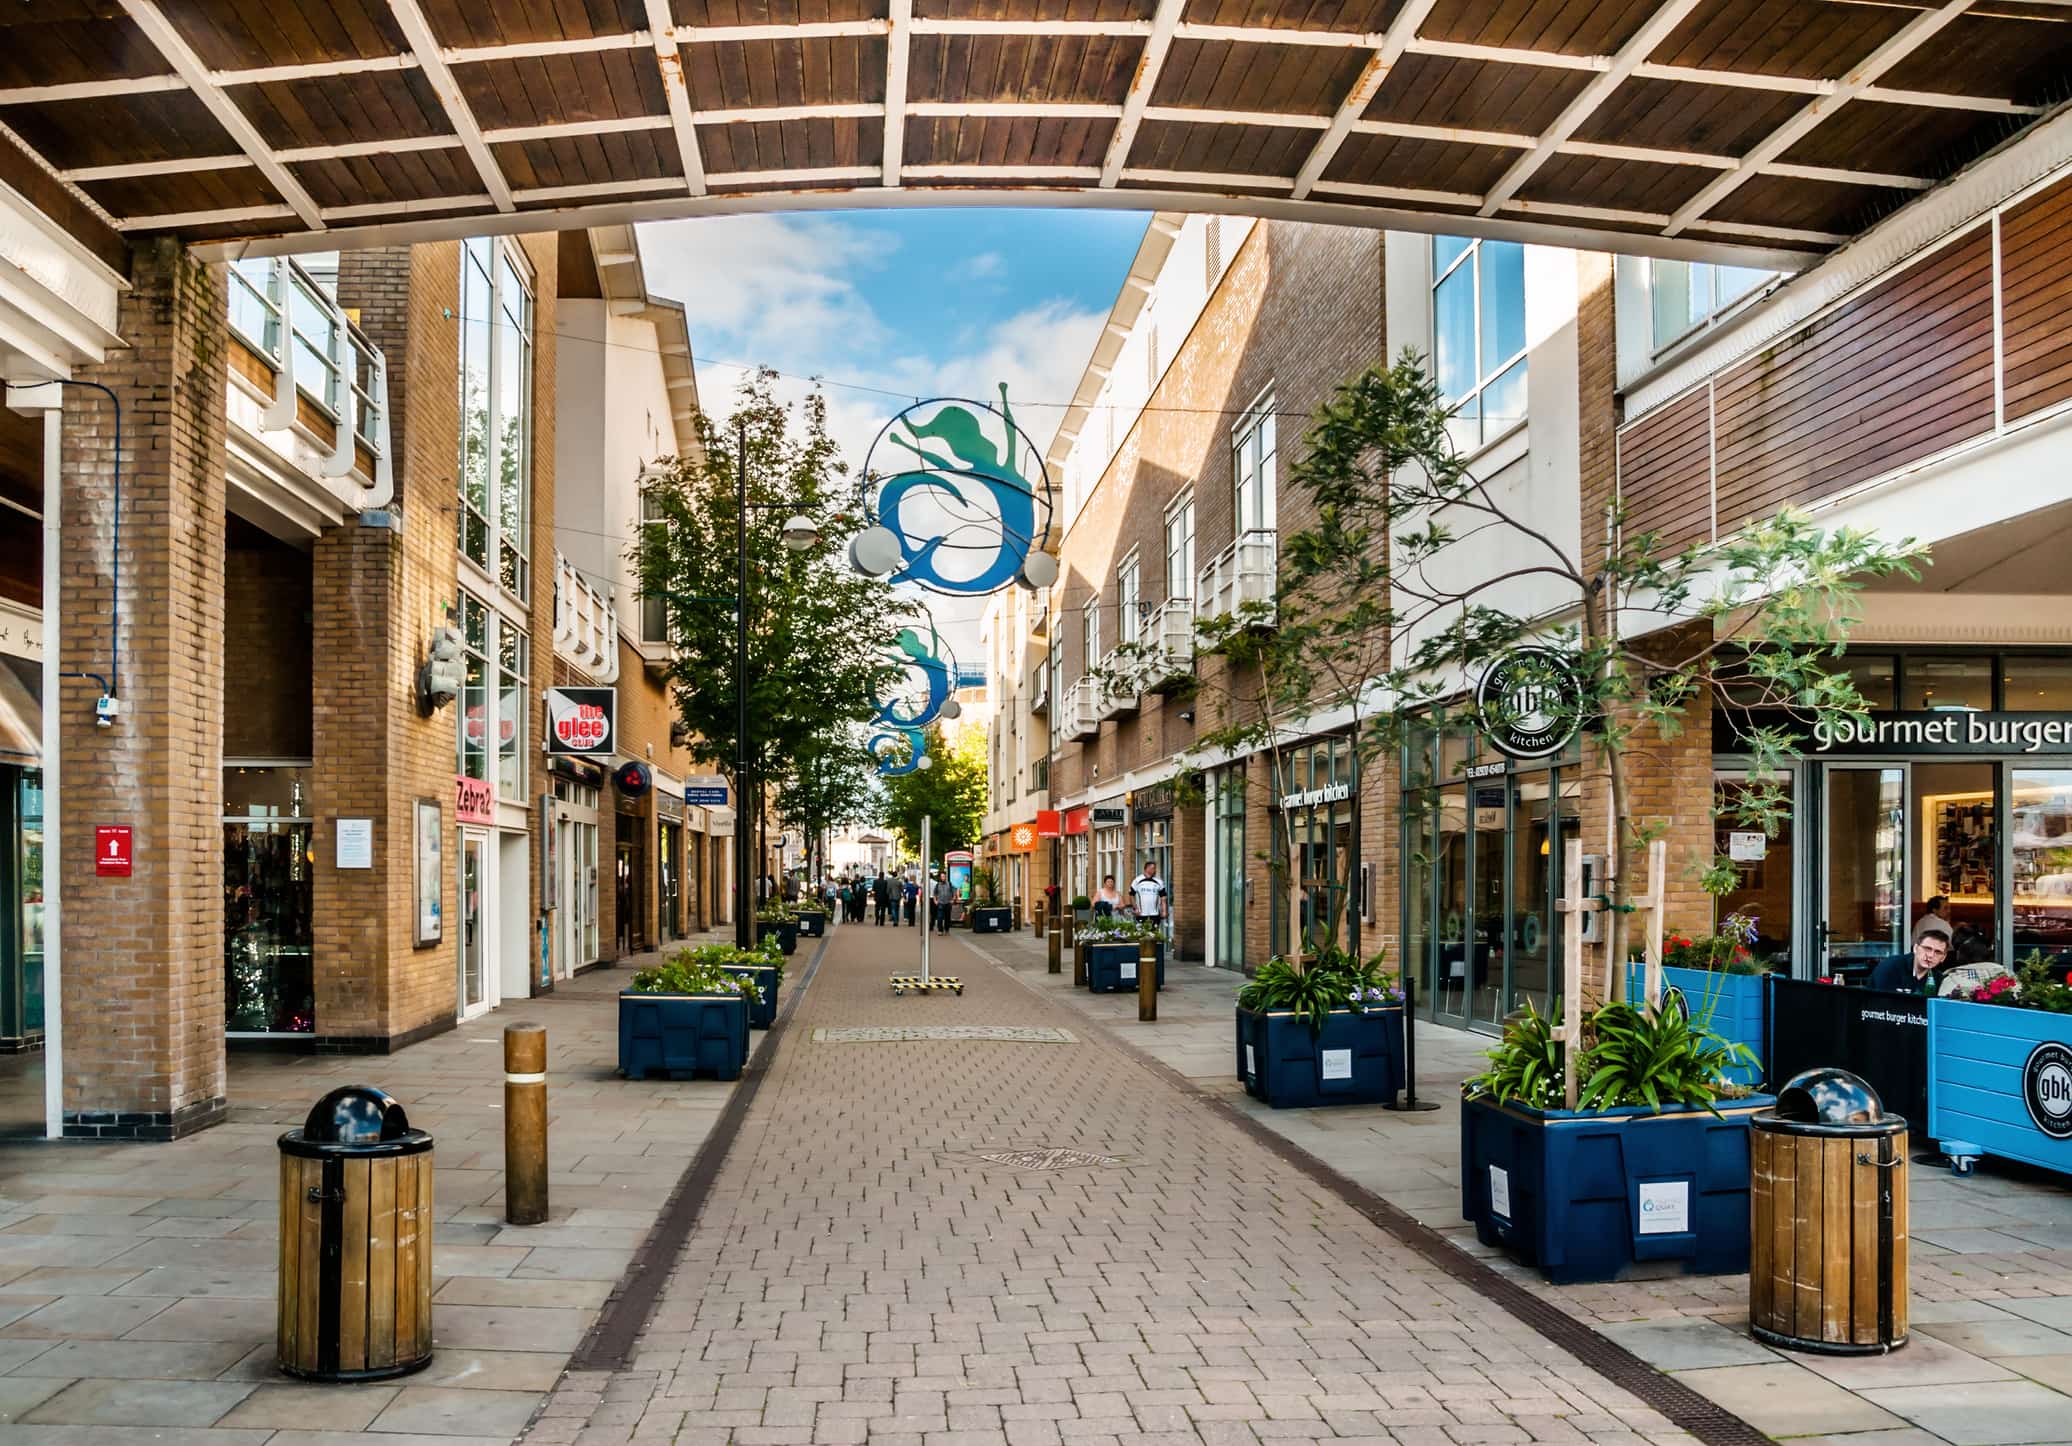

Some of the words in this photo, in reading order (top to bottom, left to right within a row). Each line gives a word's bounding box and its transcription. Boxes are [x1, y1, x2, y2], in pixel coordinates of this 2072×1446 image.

[579, 703, 604, 720] the
[558, 716, 604, 741] glee
[1509, 732, 1554, 748] kitchen
[1812, 715, 1958, 752] gourmet
[1968, 712, 2072, 753] burger
[456, 780, 491, 816] Zebra2
[1324, 780, 1349, 803] kitchen
[1886, 1009, 1907, 1026] burger
[2041, 1074, 2071, 1102] gbk
